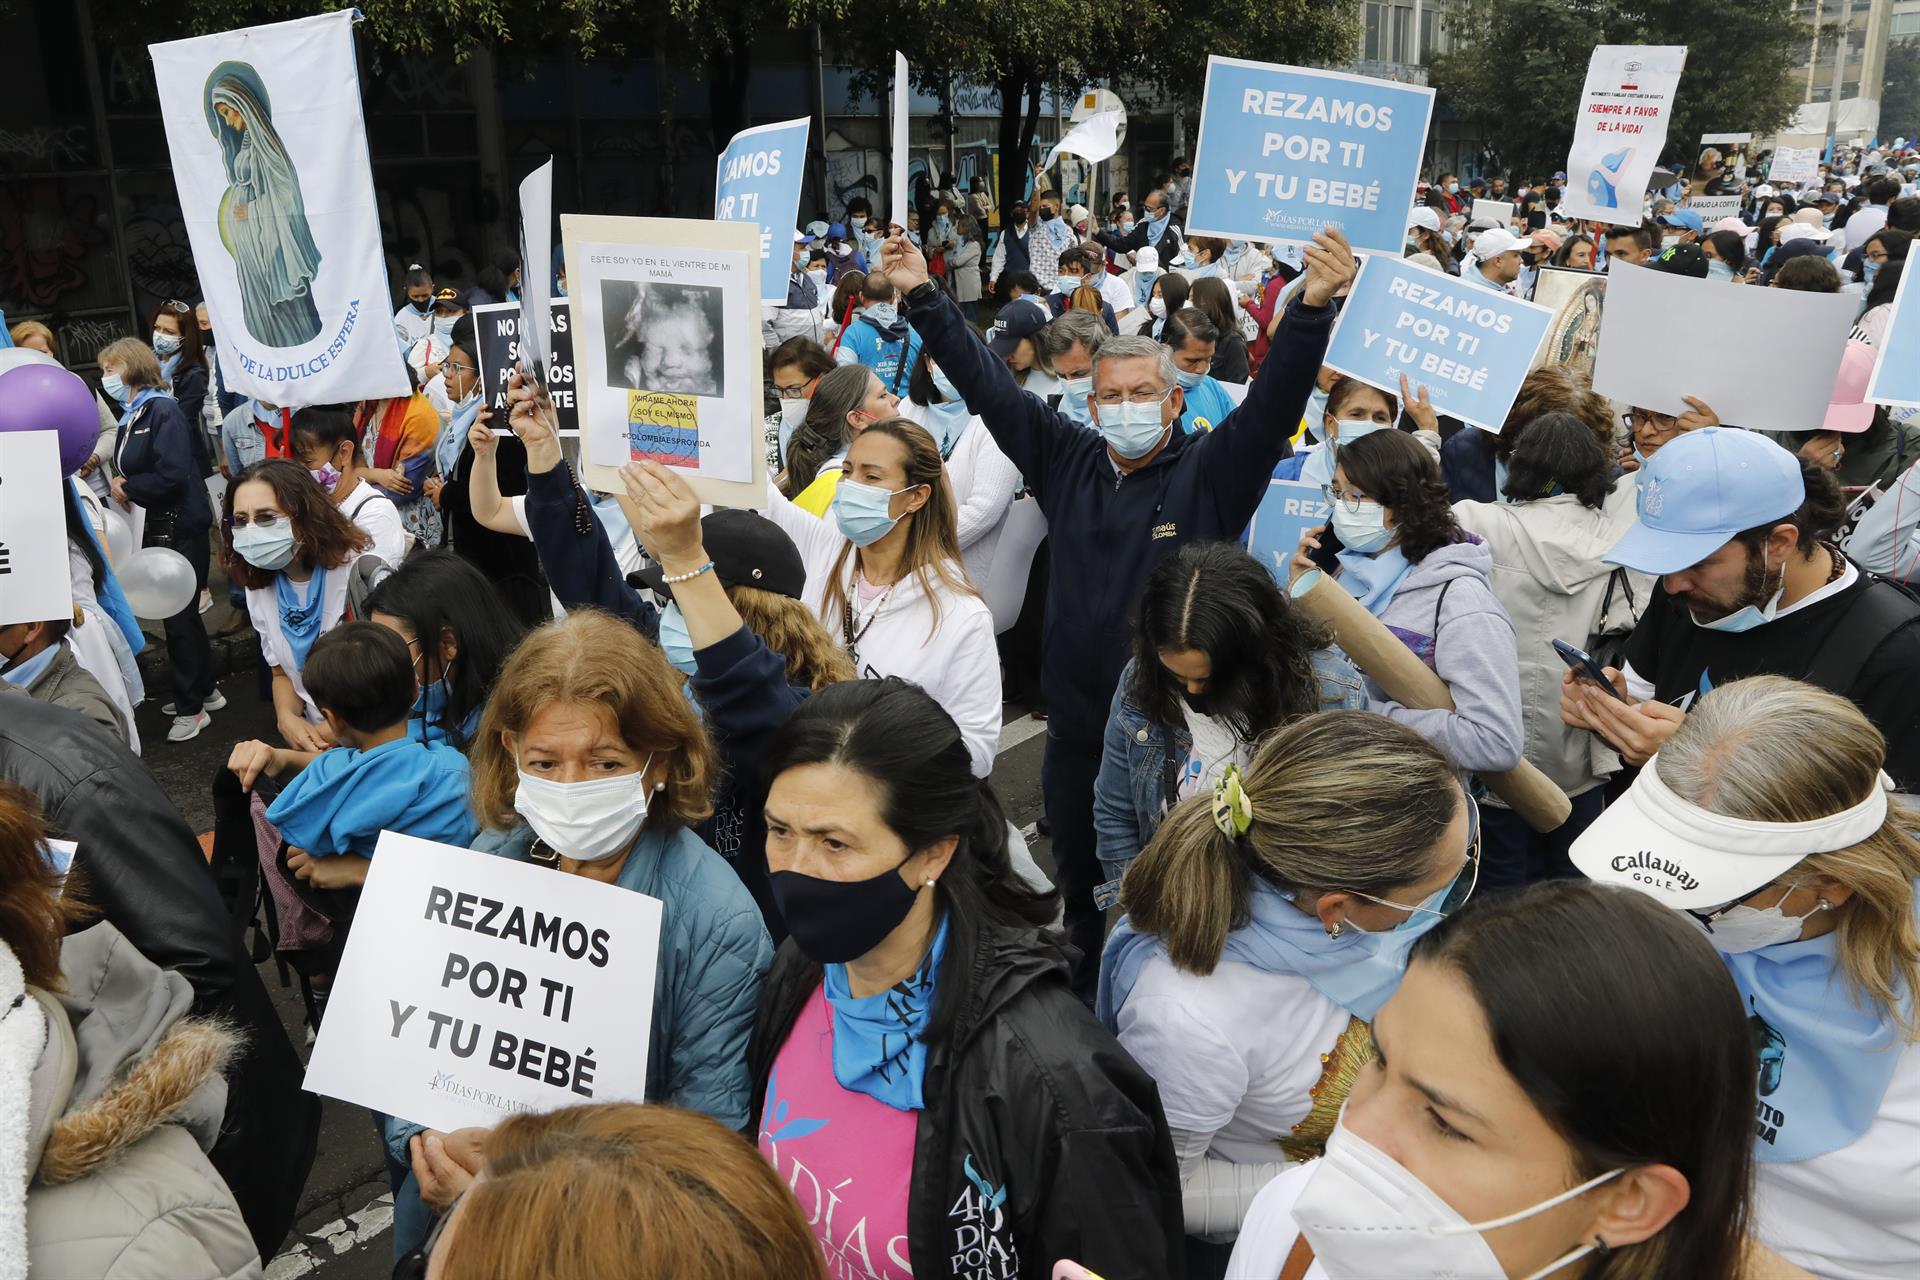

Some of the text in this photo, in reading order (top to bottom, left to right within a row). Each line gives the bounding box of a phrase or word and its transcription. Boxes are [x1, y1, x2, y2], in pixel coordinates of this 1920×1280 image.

[1241, 87, 1393, 132] REZAMOS
[1596, 121, 1644, 135] DE LA VIDA!
[1625, 105, 1631, 115] A
[1633, 106, 1659, 117] FAVOR
[1261, 132, 1365, 169] POR TI
[740, 192, 759, 219] TI
[1225, 168, 1382, 212] Y TU BEBÉ
[590, 255, 731, 272] ESTE SOY YO EN EL VIENTRE DE MI
[1387, 276, 1513, 334] REZAMOS
[240, 299, 360, 382] DE LA DULCE ESPERA
[497, 318, 515, 337] NO
[1395, 311, 1480, 356] POR TI
[1363, 328, 1381, 349] Y
[1384, 337, 1418, 364] TU
[1419, 351, 1489, 392] BEBÉ
[667, 398, 697, 407] AHORA!
[621, 432, 711, 448] #COLOMBIAESPROVIDA
[1272, 550, 1289, 568] Y
[1611, 850, 1700, 891] Callaway
[1633, 872, 1673, 890] GOLF
[423, 885, 611, 968] REZAMOS
[440, 952, 574, 1024] POR TI
[389, 999, 597, 1099] Y TU BEBÉ
[473, 1088, 495, 1105] POR
[496, 1096, 511, 1112] LA
[948, 1184, 1004, 1233] 40
